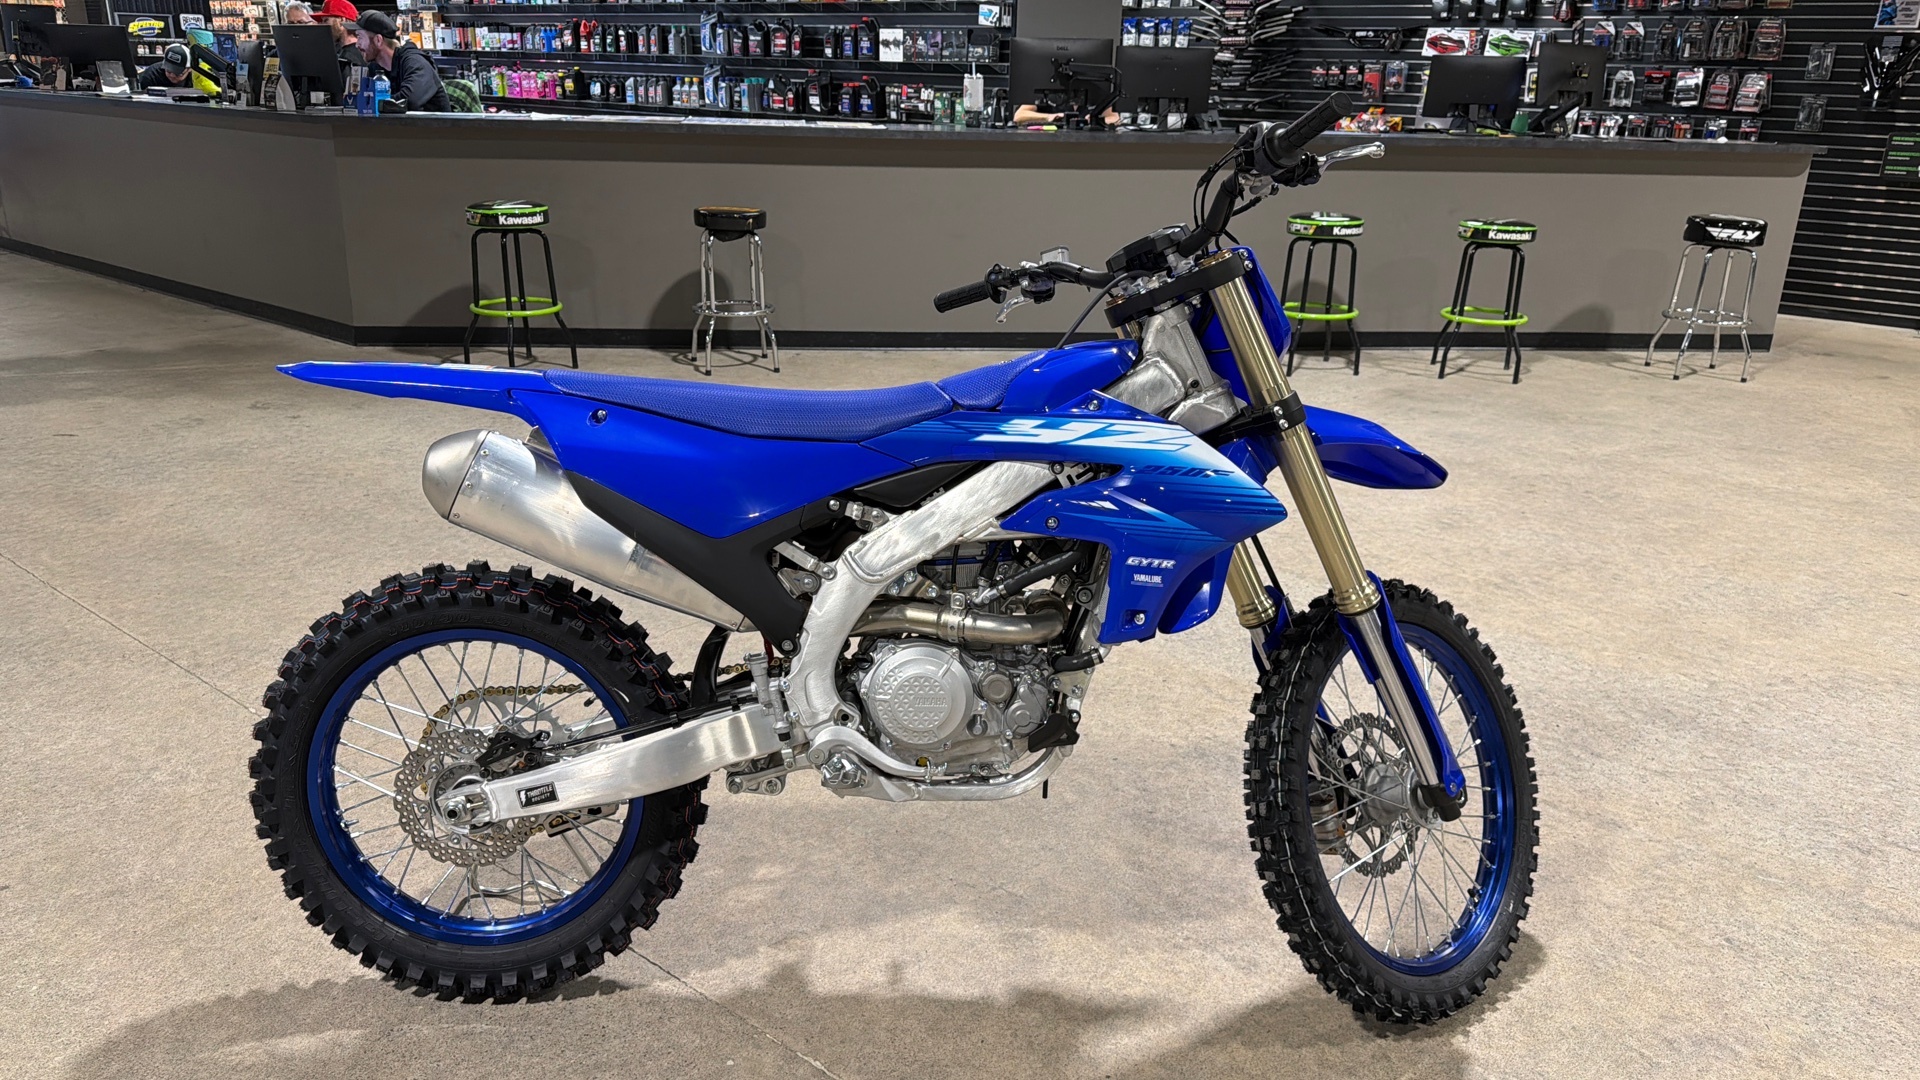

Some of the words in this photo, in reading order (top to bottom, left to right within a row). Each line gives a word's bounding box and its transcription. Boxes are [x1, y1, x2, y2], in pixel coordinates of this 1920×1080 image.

[498, 213, 544, 226] Kawasaki
[1488, 230, 1532, 241] Kawasaki
[1705, 227, 1761, 241] FLY
[969, 418, 1193, 452] YZ
[1138, 465, 1235, 479] 250F
[1125, 556, 1176, 569] GYTR
[1133, 573, 1162, 584] YAMALUBE
[914, 697, 948, 707] YAMAHA
[526, 784, 553, 798] THROTTLE
[531, 792, 551, 803] SOCIETY
